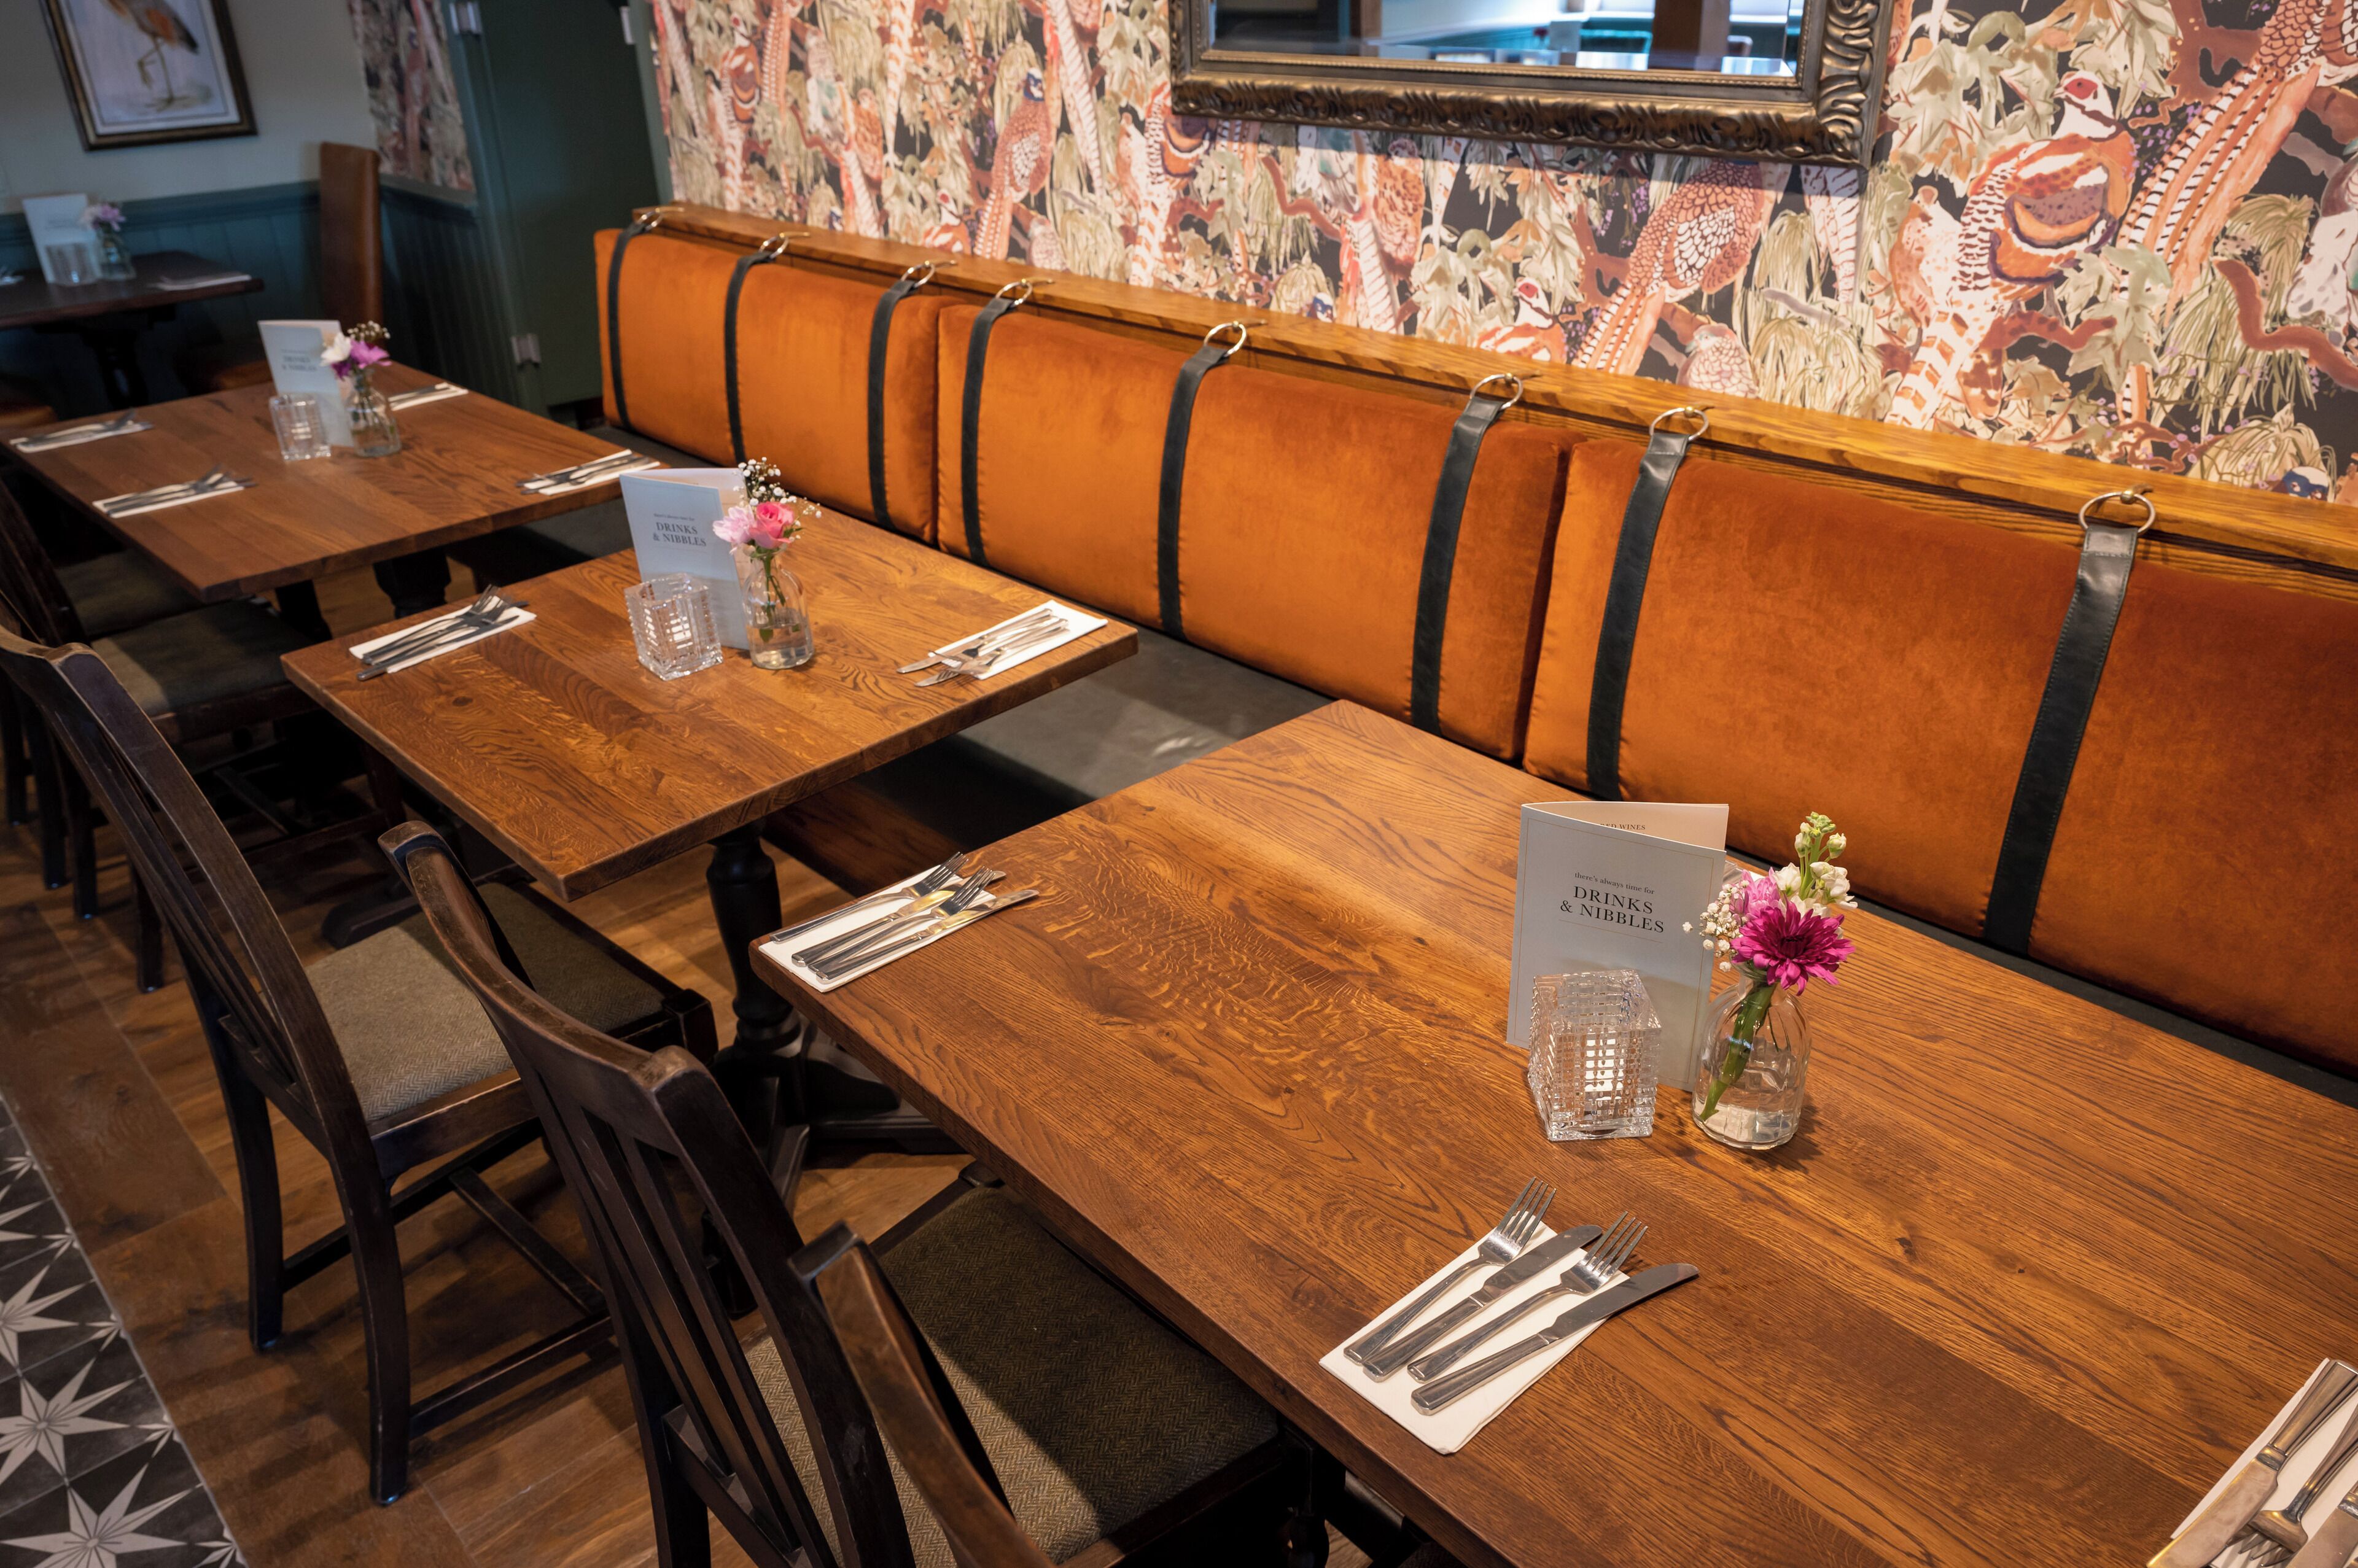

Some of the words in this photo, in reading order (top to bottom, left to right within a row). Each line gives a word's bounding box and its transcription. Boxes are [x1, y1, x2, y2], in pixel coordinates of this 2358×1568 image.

[656, 522, 698, 535] DRINKS
[663, 534, 707, 546] NIBBLES
[1600, 878, 1624, 888] always
[1626, 883, 1643, 892] time
[1573, 886, 1653, 914] DRINKS
[1560, 900, 1573, 914] &
[1579, 904, 1664, 933] NIBBLES
